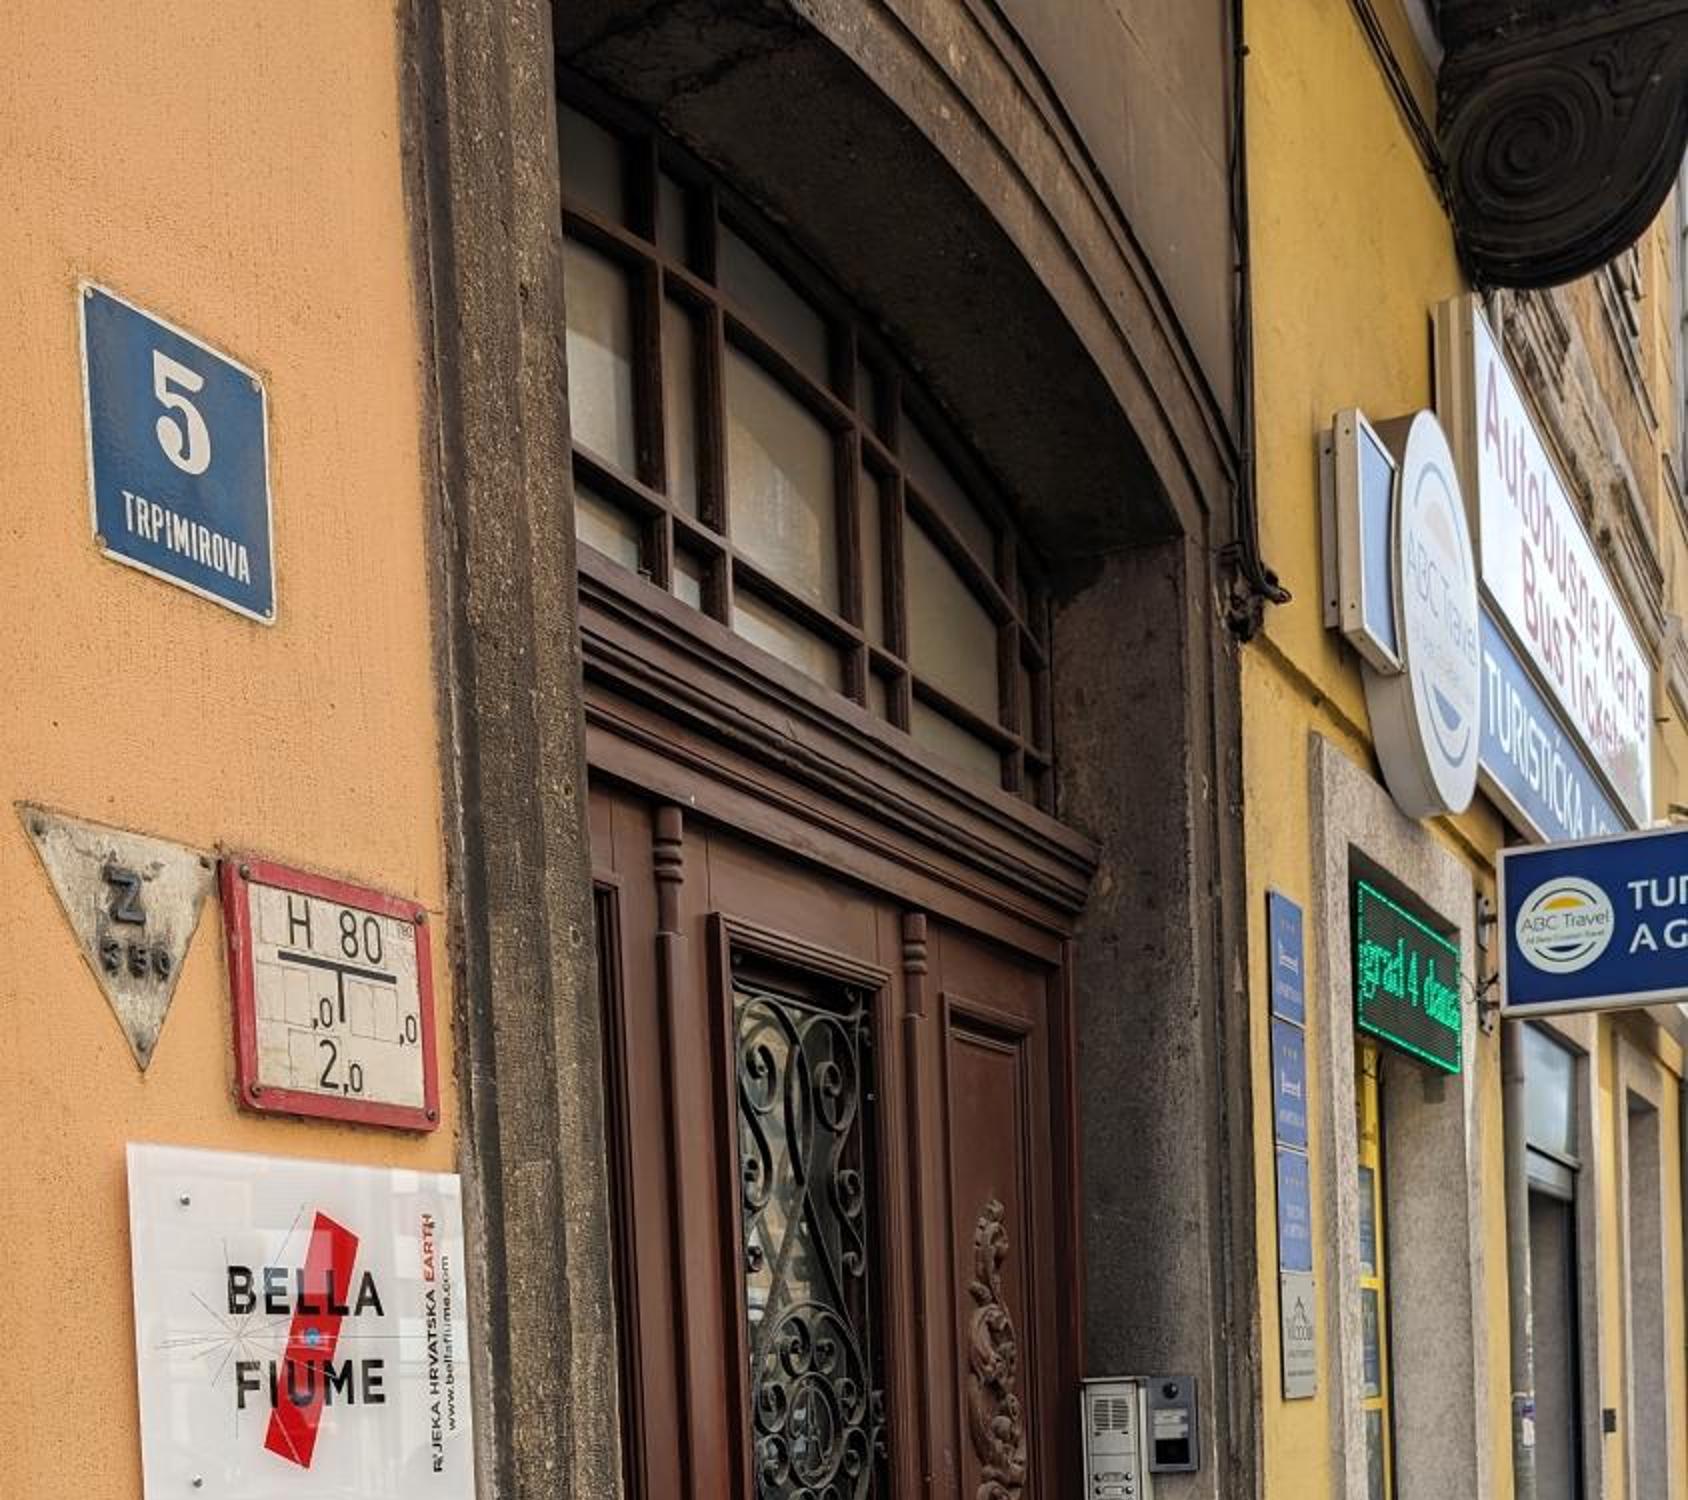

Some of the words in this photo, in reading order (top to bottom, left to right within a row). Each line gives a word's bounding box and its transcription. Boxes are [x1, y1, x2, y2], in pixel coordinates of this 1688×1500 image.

[153, 349, 211, 475] 5
[122, 491, 251, 584] TRPIMIROVA
[1484, 359, 1600, 659] Autobusne
[1605, 600, 1645, 742] Karte
[1521, 536, 1564, 687] Bus
[1521, 914, 1558, 933] ABC
[1562, 908, 1611, 928] Travel
[1627, 875, 1688, 911] TU
[287, 895, 312, 949] H
[338, 909, 383, 964] 80
[1408, 950, 1419, 1007] 4
[319, 1038, 364, 1094] 2,0
[227, 1265, 385, 1316] BELLA
[425, 1289, 441, 1395] HRVATSKA
[235, 1359, 386, 1409] FIUME
